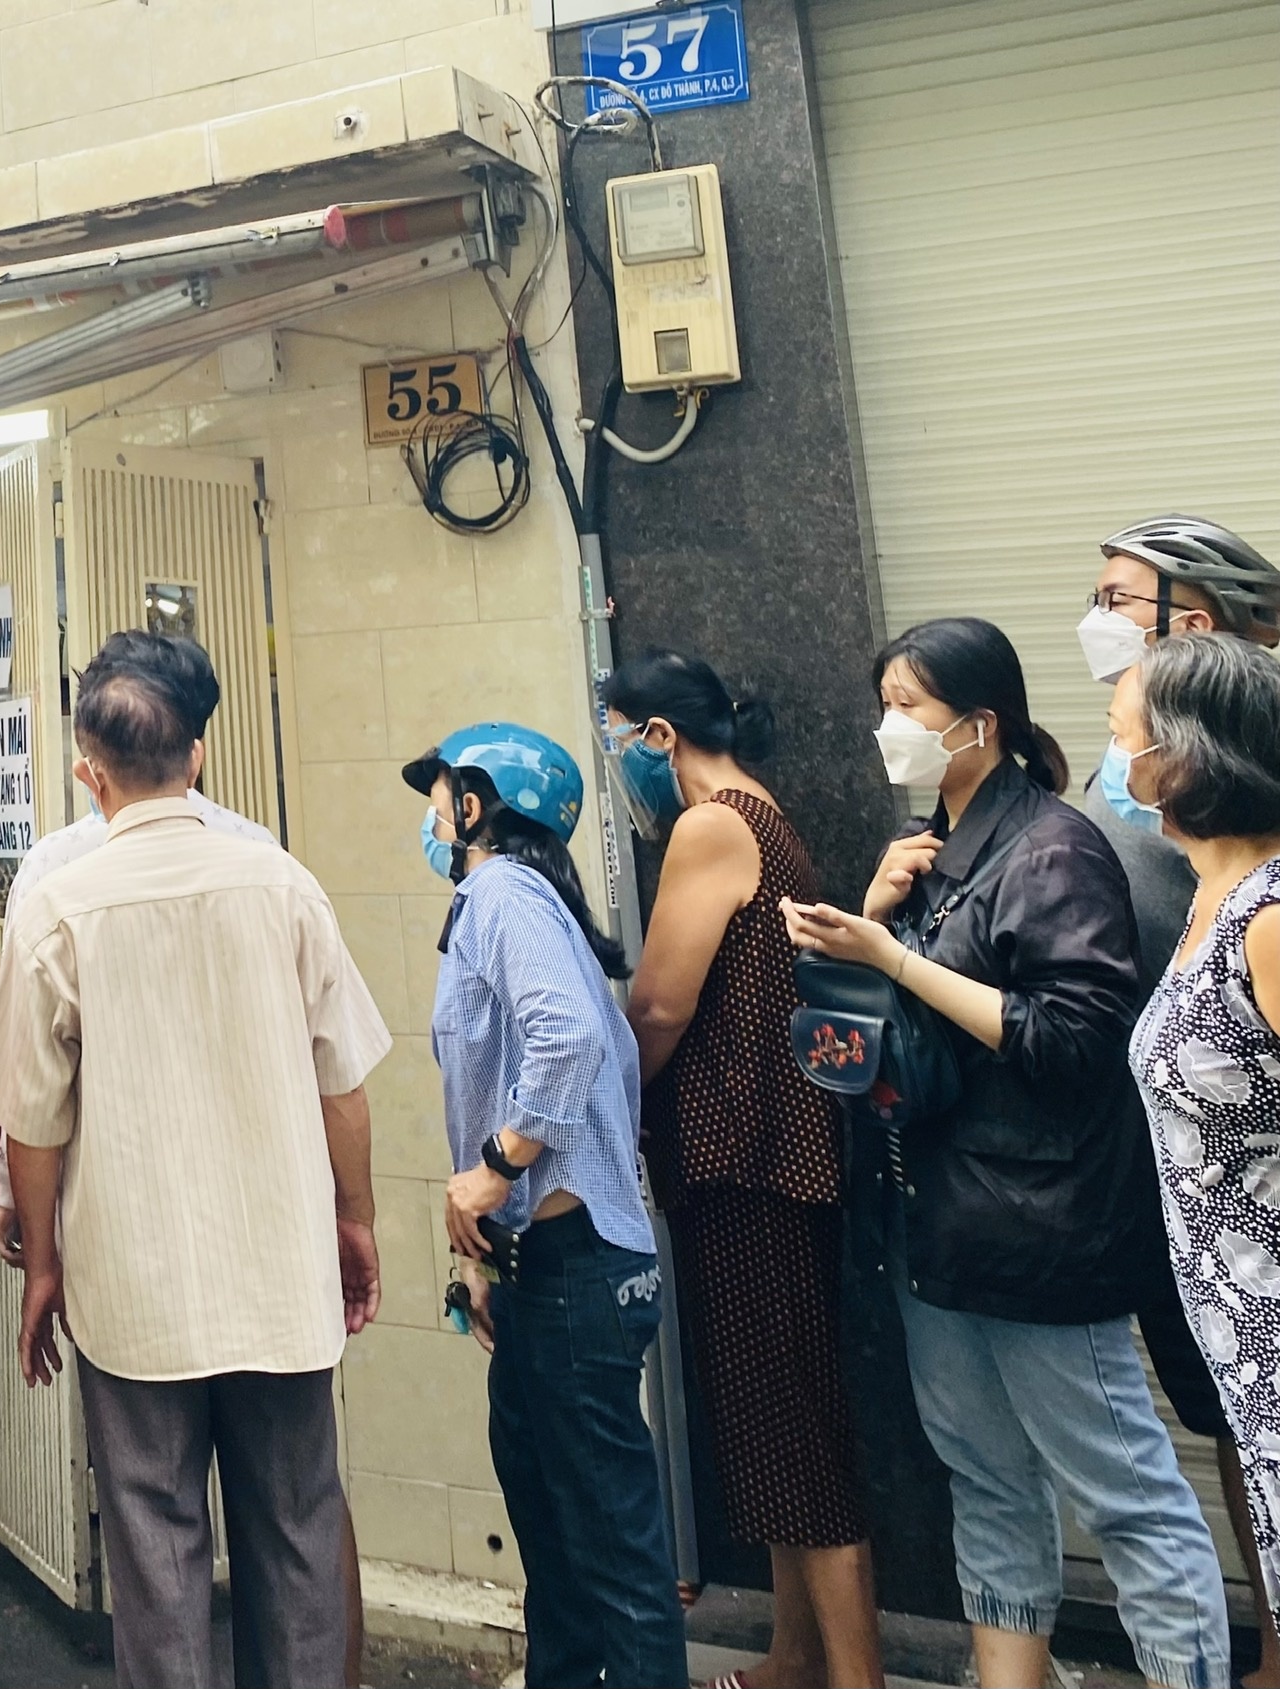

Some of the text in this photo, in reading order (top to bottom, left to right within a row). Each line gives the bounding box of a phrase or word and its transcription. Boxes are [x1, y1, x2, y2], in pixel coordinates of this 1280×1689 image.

[619, 15, 709, 80] 57
[649, 89, 660, 101] CX
[721, 75, 735, 91] Q.3
[387, 363, 461, 421] 55
[17, 773, 21, 805] 1
[19, 821, 32, 850] 12
